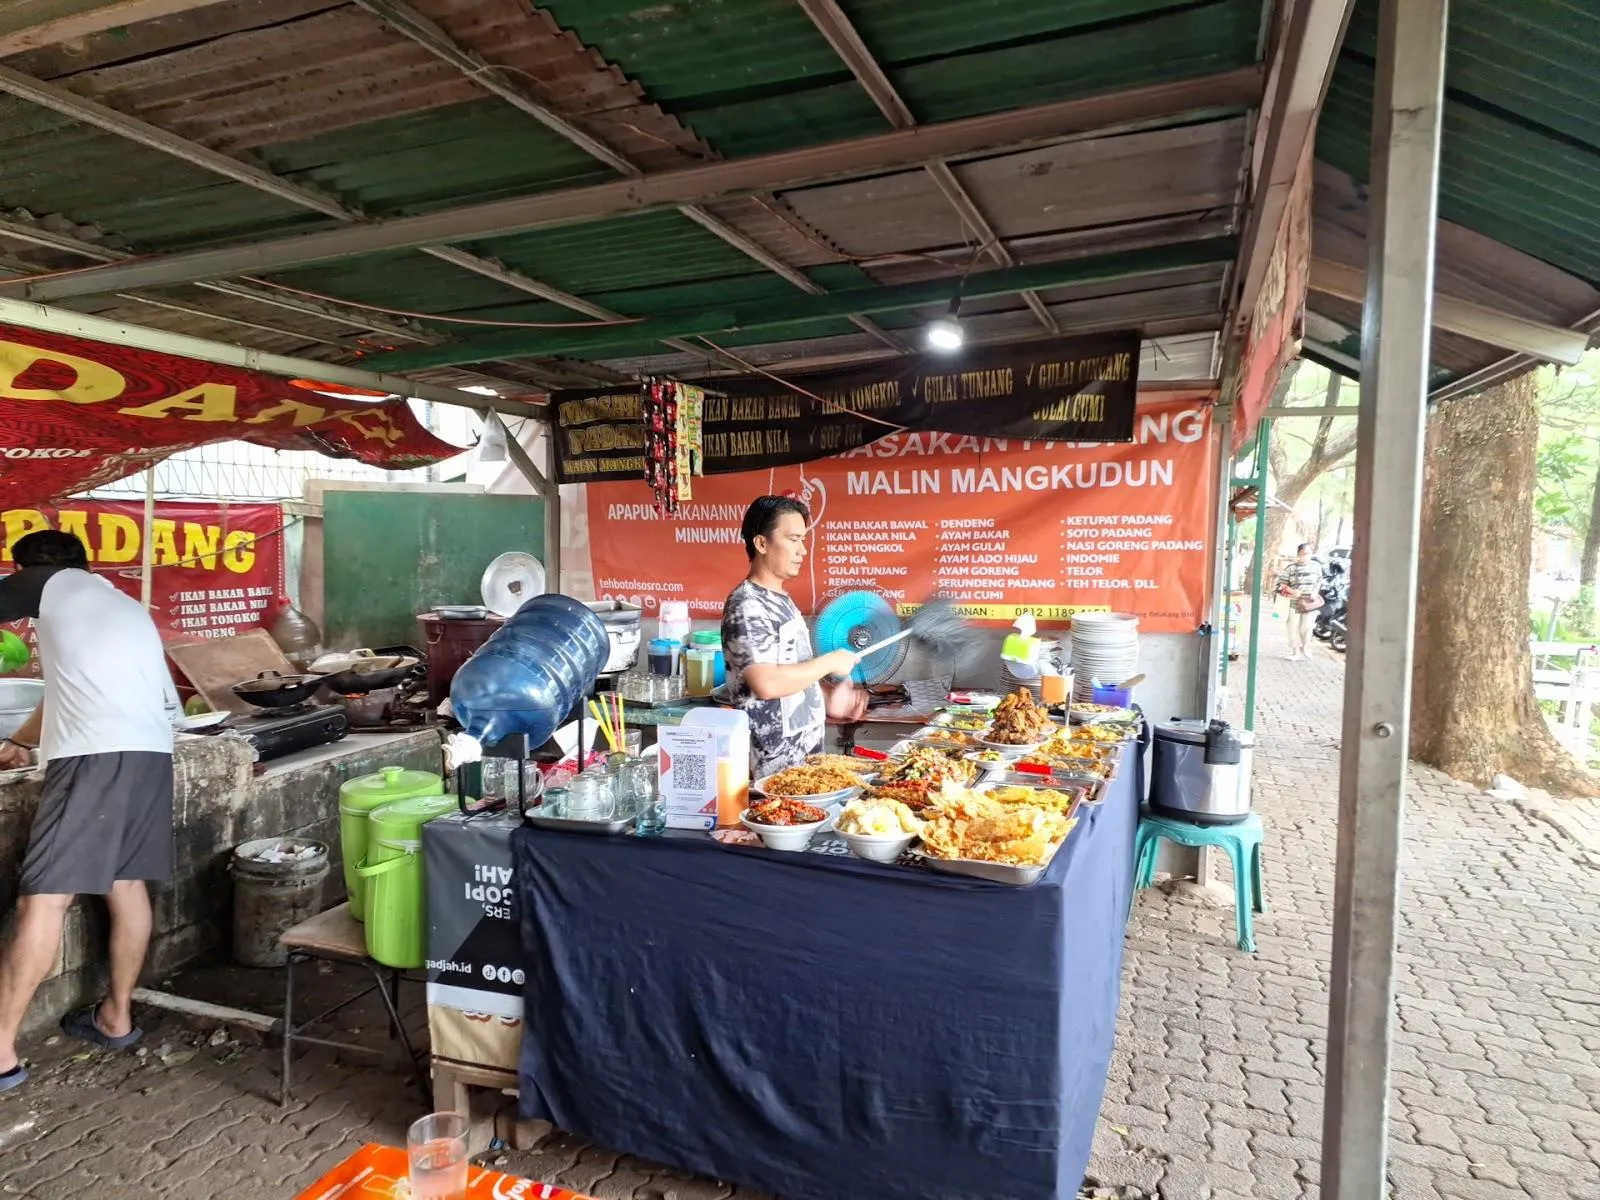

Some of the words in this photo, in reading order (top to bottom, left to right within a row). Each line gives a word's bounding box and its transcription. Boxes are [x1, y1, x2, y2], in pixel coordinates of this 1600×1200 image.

[1039, 362, 1074, 389] GULAI
[924, 376, 958, 402] GULAI
[961, 368, 1014, 399] TUNJANG
[559, 394, 640, 426] MASAK
[731, 396, 764, 420] BAKAR
[768, 393, 801, 418] BAWAL
[1072, 394, 1105, 422] CUMI
[568, 424, 645, 455] PADAN
[820, 425, 841, 449] SOP
[731, 430, 763, 456] BAKAR
[766, 429, 790, 454] NILA
[829, 432, 1008, 459] ASAKAN
[847, 471, 940, 496] MALIN
[952, 460, 1173, 494] MANGKUDUN
[608, 503, 658, 520] APAPUN
[827, 521, 850, 530] IKAN
[853, 521, 888, 530] BAKAR
[890, 520, 928, 529] BAWAL
[941, 519, 995, 529] DENDENG
[1067, 516, 1119, 525] KETUPAT
[1122, 515, 1172, 525] PADANG
[827, 532, 850, 541] IKAN
[853, 532, 887, 541] BAKAR
[890, 531, 917, 541] NILA
[941, 531, 971, 540] AYAM
[974, 530, 1010, 539] BAKAR
[1066, 529, 1099, 538] SOTO
[1102, 528, 1152, 538] PADANG
[828, 544, 851, 553] IKAN
[854, 544, 904, 553] TONGKOL
[941, 543, 970, 552] AYAM
[972, 542, 1006, 552] GULAI
[1067, 541, 1095, 551] NASI
[1097, 541, 1149, 551] GORENG
[1152, 540, 1203, 551] PADANG
[828, 556, 848, 564] SOP
[850, 556, 868, 564] IGA
[939, 555, 969, 564] AYAM
[972, 554, 1002, 564] LADO
[1005, 554, 1038, 564] HIJAU
[1067, 554, 1120, 564] INDOMIE
[829, 567, 859, 576] GULAI
[861, 567, 907, 576] TUNJANG
[938, 566, 968, 576] AYAM
[971, 566, 1019, 576] GORENG
[1066, 567, 1103, 576] TELOR
[600, 579, 683, 592] tehbotolsosro.com
[829, 578, 877, 587] RENDANG
[938, 579, 1005, 588] SERUNDENG
[1008, 578, 1055, 588] PADANG
[1067, 579, 1089, 588] TEH
[181, 592, 205, 601] IKAN
[208, 589, 244, 600] BAKAR
[938, 590, 972, 600] GULAI
[974, 591, 1003, 600] CUMI
[181, 604, 206, 614] IKAN
[210, 601, 247, 612] BAKAR
[1015, 607, 1043, 618] 0812
[1049, 608, 1075, 618] 1189
[181, 617, 207, 628] IKAN
